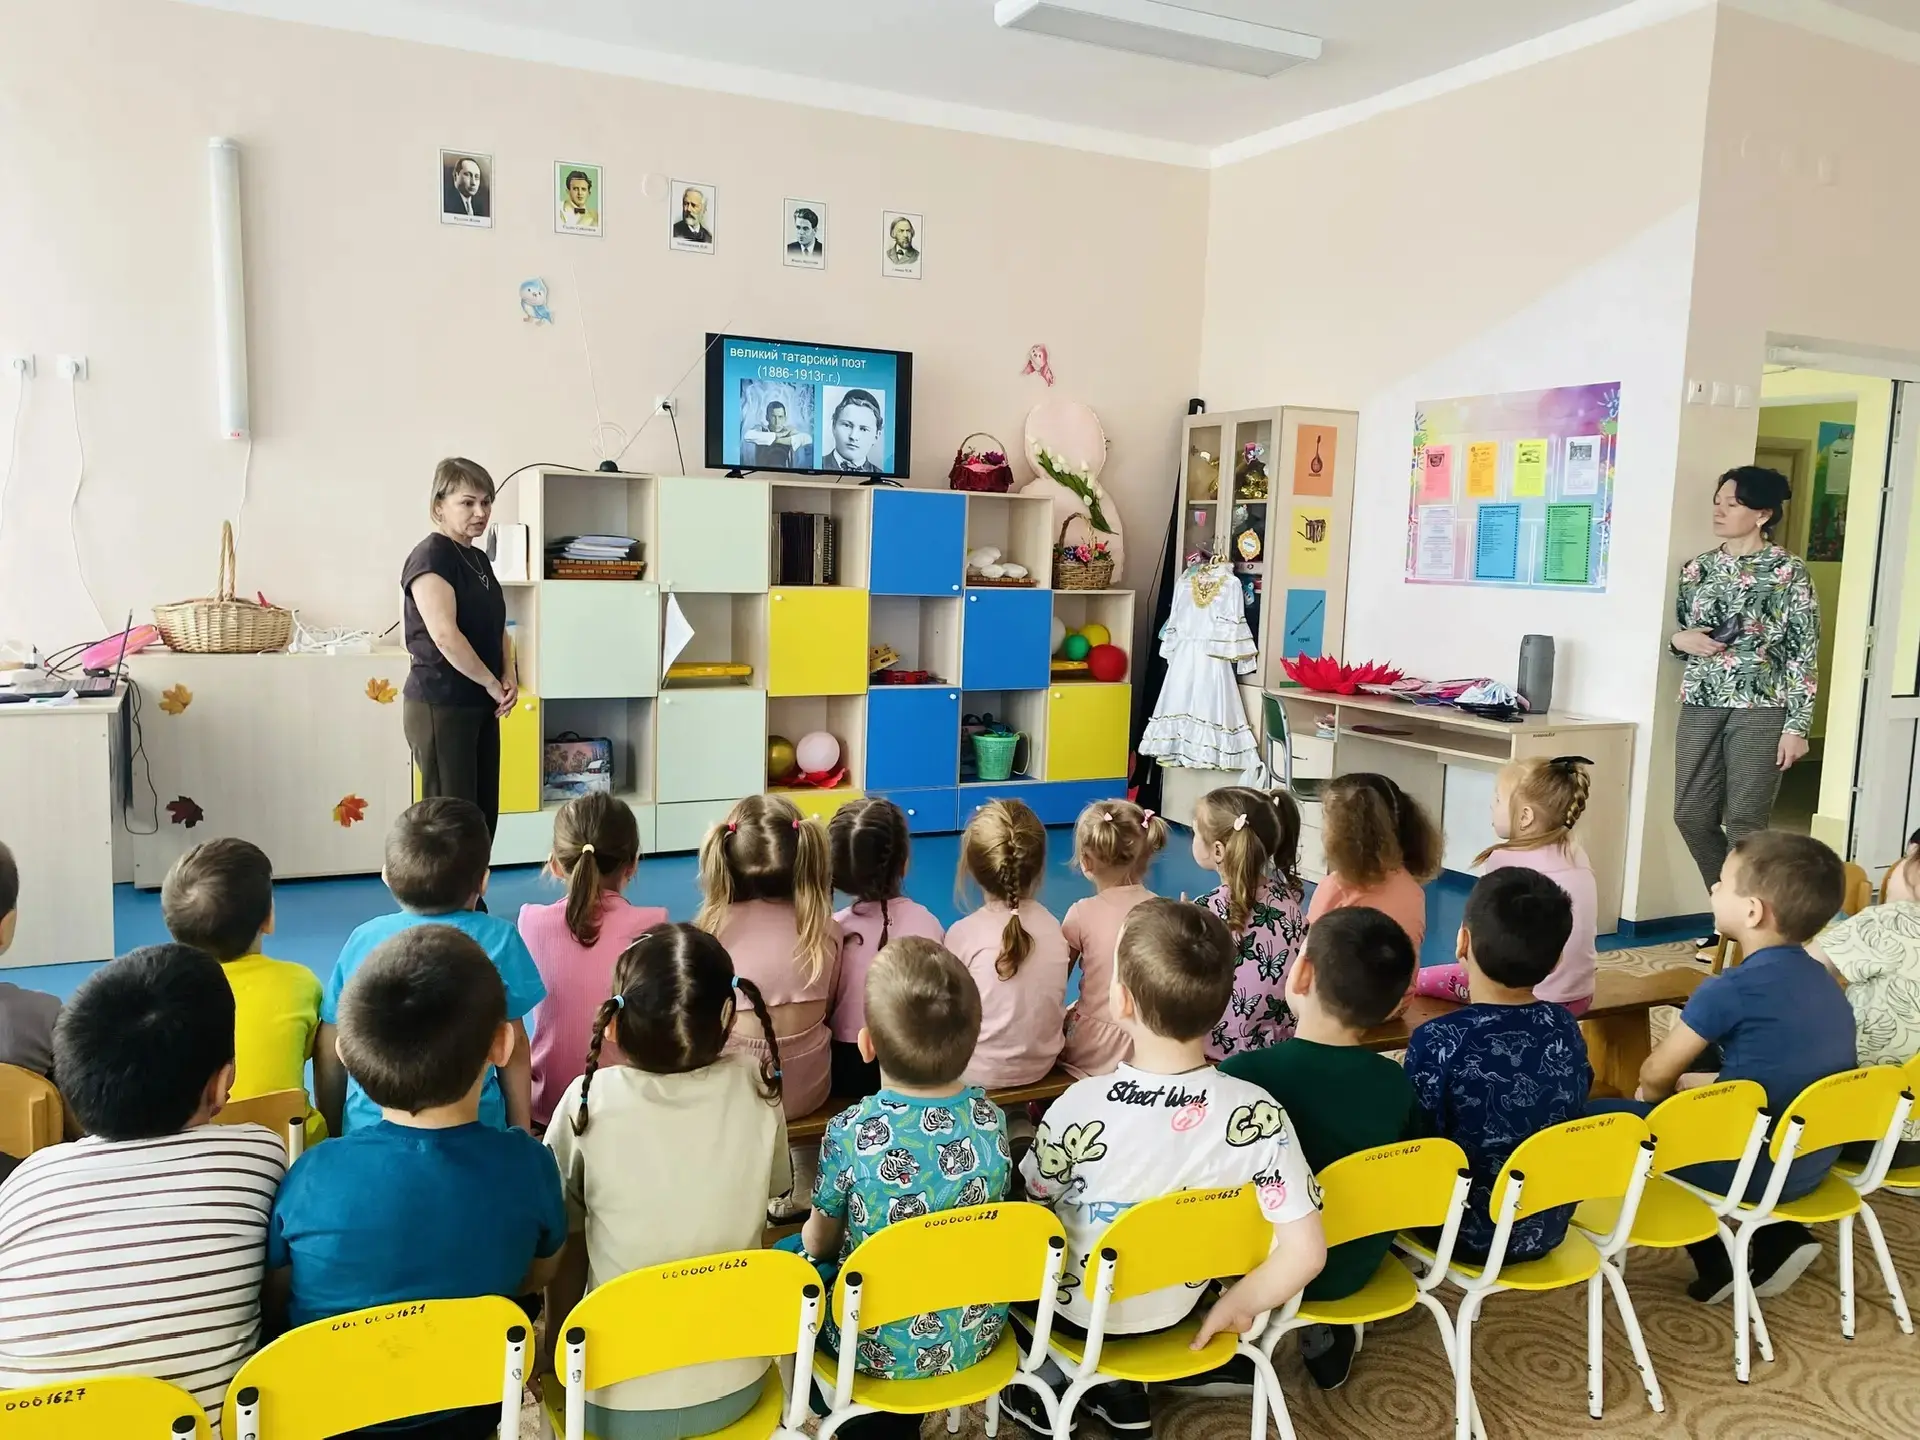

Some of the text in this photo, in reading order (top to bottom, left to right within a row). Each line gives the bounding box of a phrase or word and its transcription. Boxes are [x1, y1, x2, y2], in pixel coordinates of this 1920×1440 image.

[730, 347, 866, 369] великий татарский поэт
[757, 365, 841, 385] (1886-1913г.г.)
[1107, 1080, 1209, 1108] Street Wear
